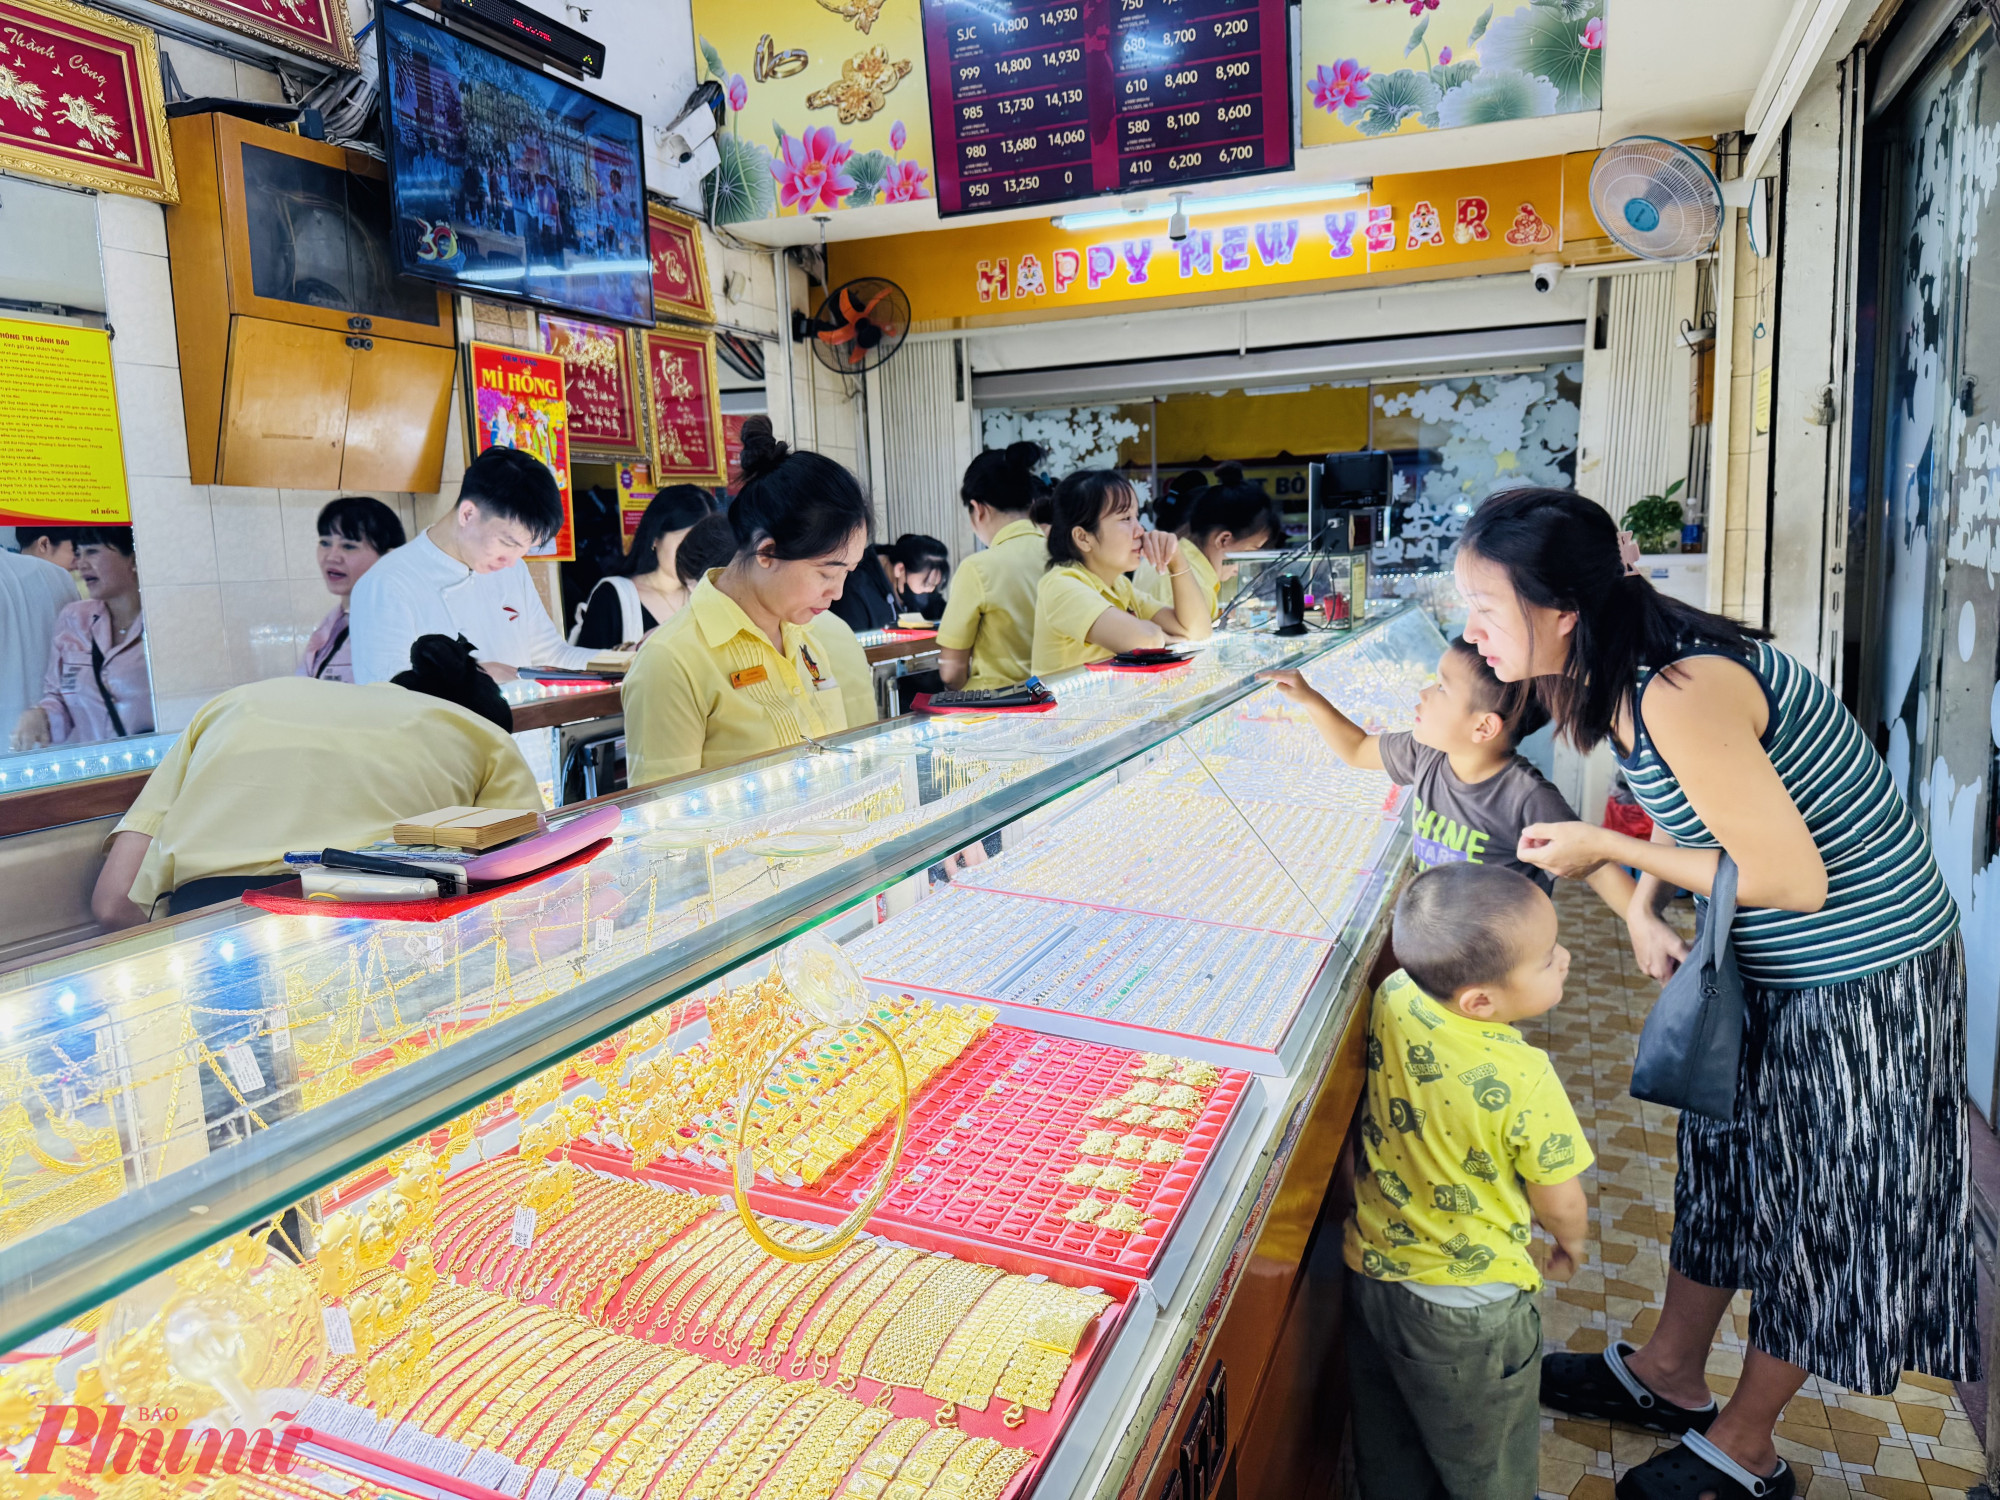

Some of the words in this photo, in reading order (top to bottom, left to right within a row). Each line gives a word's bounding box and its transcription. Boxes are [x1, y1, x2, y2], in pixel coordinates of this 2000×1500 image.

[957, 26, 977, 41] SJC
[992, 16, 1028, 35] 14,800
[1040, 8, 1078, 26] 14,930
[1123, 37, 1145, 52] 680
[1163, 28, 1196, 47] 8,700
[1213, 19, 1248, 38] 9,200
[3, 27, 55, 59] Thành
[69, 54, 107, 87] Công
[959, 66, 980, 80] 999
[995, 57, 1031, 75] 14,800
[1043, 49, 1080, 67] 14,930
[1125, 78, 1148, 94] 610
[1165, 70, 1198, 89] 8,400
[1216, 62, 1250, 81] 8,900
[963, 105, 983, 120] 985
[998, 97, 1034, 115] 13,730
[1045, 89, 1083, 107] 14,130
[1127, 119, 1150, 134] 580
[1167, 112, 1200, 130] 8,100
[1217, 104, 1251, 122] 8,600
[966, 144, 986, 158] 980
[1000, 136, 1037, 154] 13,680
[1048, 129, 1085, 147] 14,060
[1130, 160, 1152, 174] 410
[1168, 153, 1201, 171] 6,200
[1219, 145, 1253, 163] 6,700
[969, 183, 989, 197] 950
[1003, 176, 1039, 194] 13,250
[1064, 171, 1073, 183] 0
[976, 238, 1153, 302] HAPPY
[1172, 219, 1299, 278] NEW
[1324, 196, 1490, 258] YEAR
